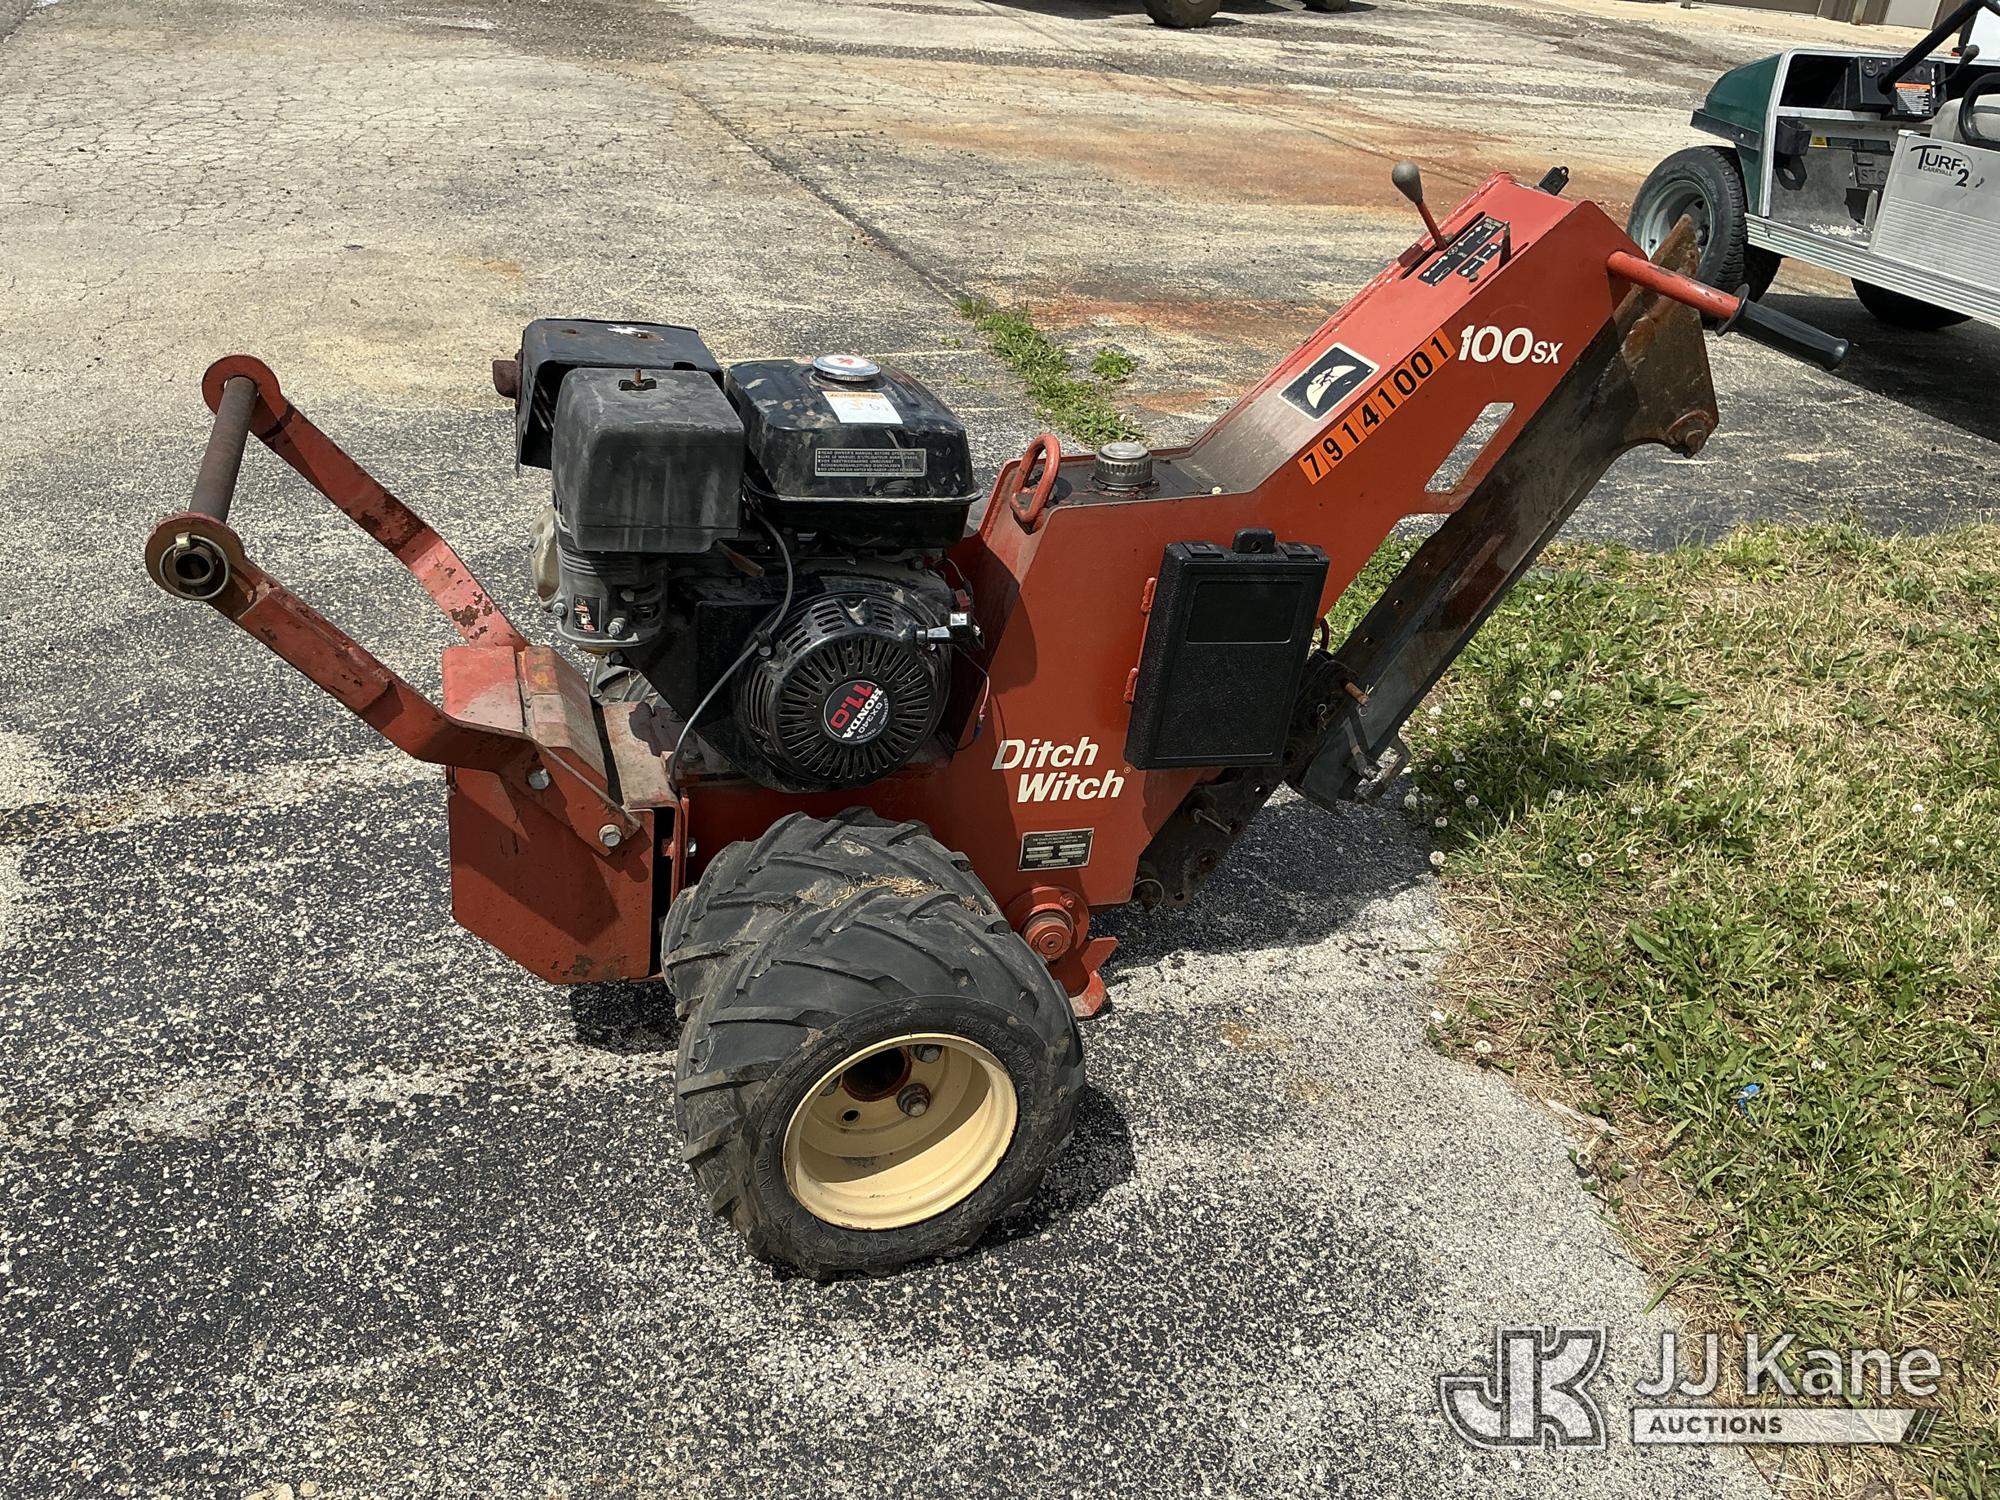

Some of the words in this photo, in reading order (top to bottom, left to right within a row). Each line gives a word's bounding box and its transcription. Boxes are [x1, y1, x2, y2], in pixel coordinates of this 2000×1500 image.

[1922, 165, 1953, 177] CARRYALL
[1954, 168, 1970, 188] 2
[1302, 335, 1451, 479] 79141001
[830, 684, 873, 729] 11.0
[842, 687, 884, 739] HONDA
[857, 702, 883, 734] GX340
[991, 736, 1100, 771] Ditch
[1016, 769, 1126, 804] Witch
